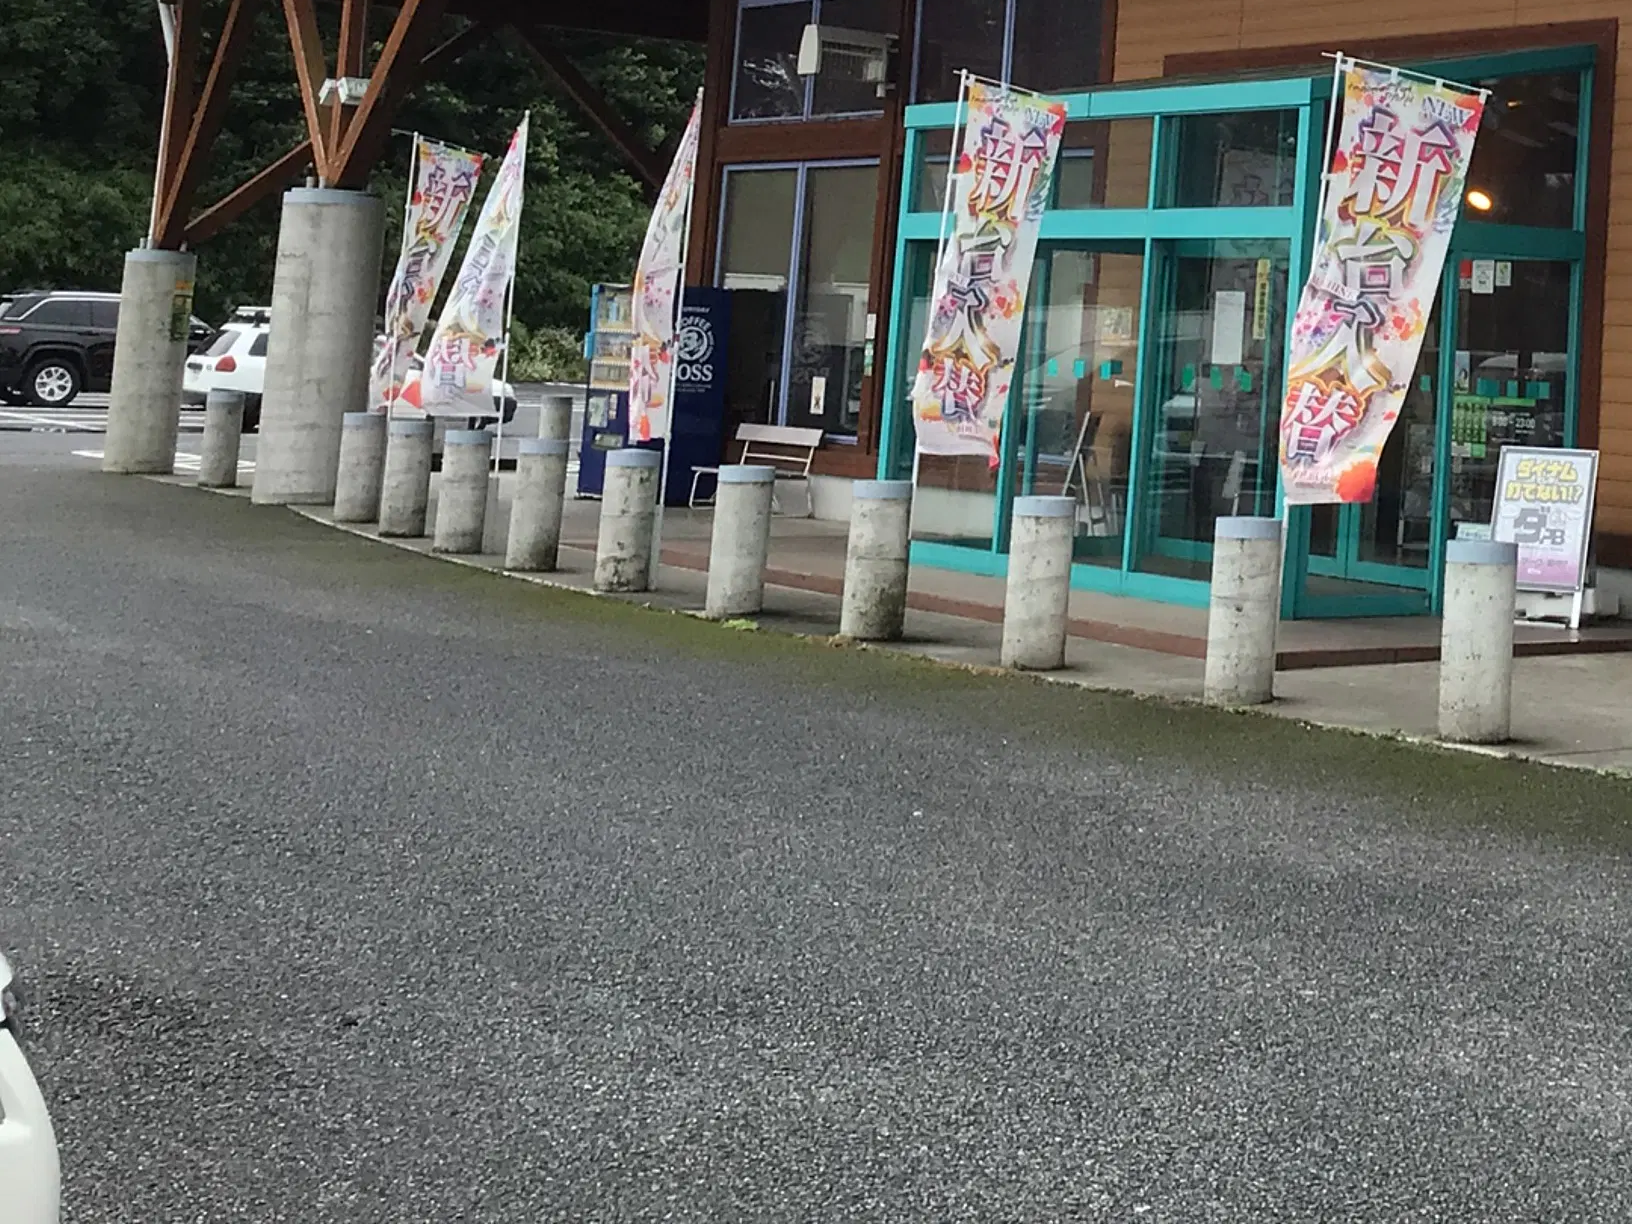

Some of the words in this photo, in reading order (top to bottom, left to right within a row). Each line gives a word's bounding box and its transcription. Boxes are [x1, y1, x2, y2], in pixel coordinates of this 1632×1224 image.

[1422, 96, 1475, 124] NEW
[932, 116, 1048, 419] 新台入替
[1283, 104, 1460, 461] 新台入替
[681, 315, 712, 331] OFFEE
[677, 363, 713, 382] OSS
